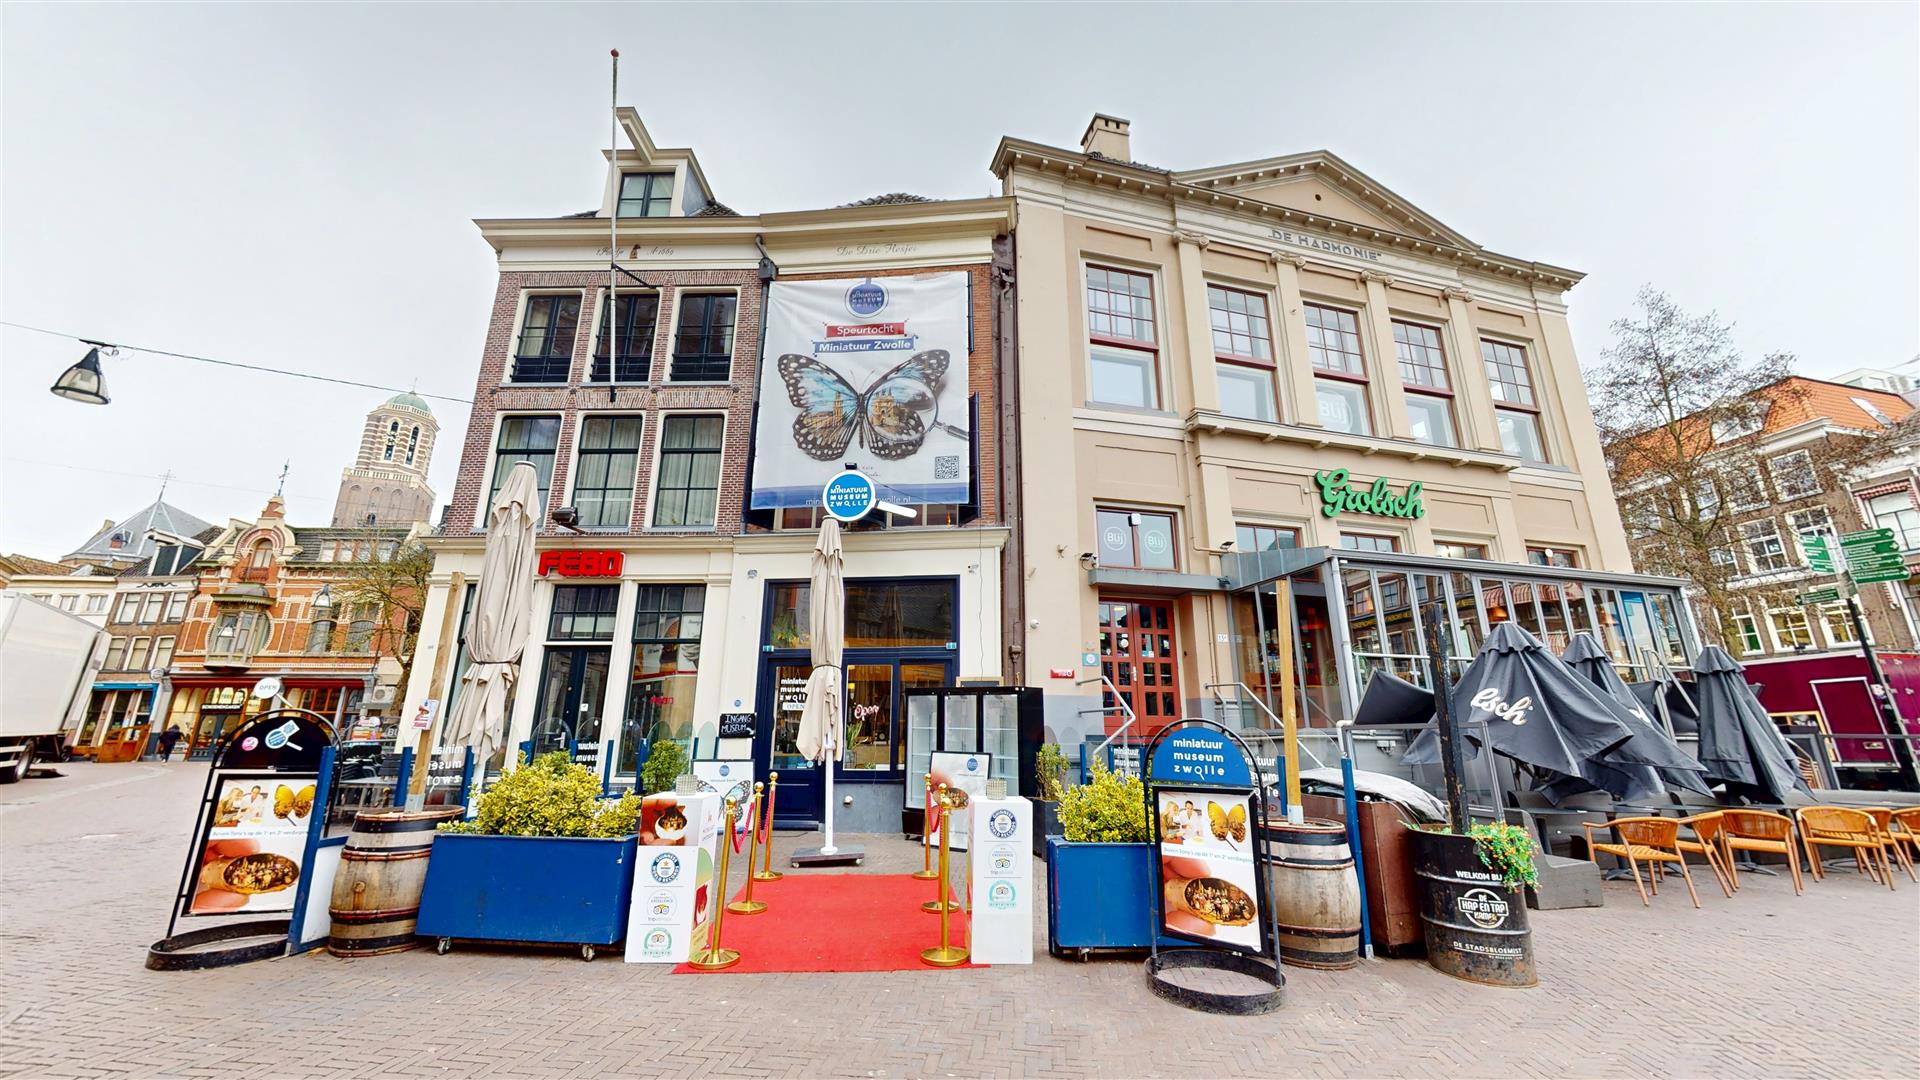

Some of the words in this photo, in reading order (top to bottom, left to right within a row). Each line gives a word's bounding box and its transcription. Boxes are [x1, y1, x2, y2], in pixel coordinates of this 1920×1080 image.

[836, 323, 894, 337] Speurtocht
[819, 342, 872, 351] Miniatuur
[873, 340, 911, 350] Zwolle
[830, 485, 868, 494] MINIATUUR
[1315, 468, 1425, 520] Grolsch
[830, 493, 868, 501] MUSEUM
[538, 551, 624, 577] FEBO
[780, 693, 806, 703] zwoll
[854, 704, 879, 721] Open
[725, 714, 752, 723] INGANG
[721, 724, 747, 734] MUSEUM
[1173, 738, 1223, 750] miniatuur
[1173, 752, 1224, 763] museum
[1174, 765, 1225, 779] zwolle
[1455, 870, 1490, 881] WELKOM
[1491, 873, 1503, 881] BIJ
[1478, 894, 1488, 902] DE
[1461, 900, 1479, 911] HAP
[1479, 903, 1490, 912] EN
[1489, 904, 1505, 913] TAP
[1464, 943, 1523, 954] STADSBLOEMIST
